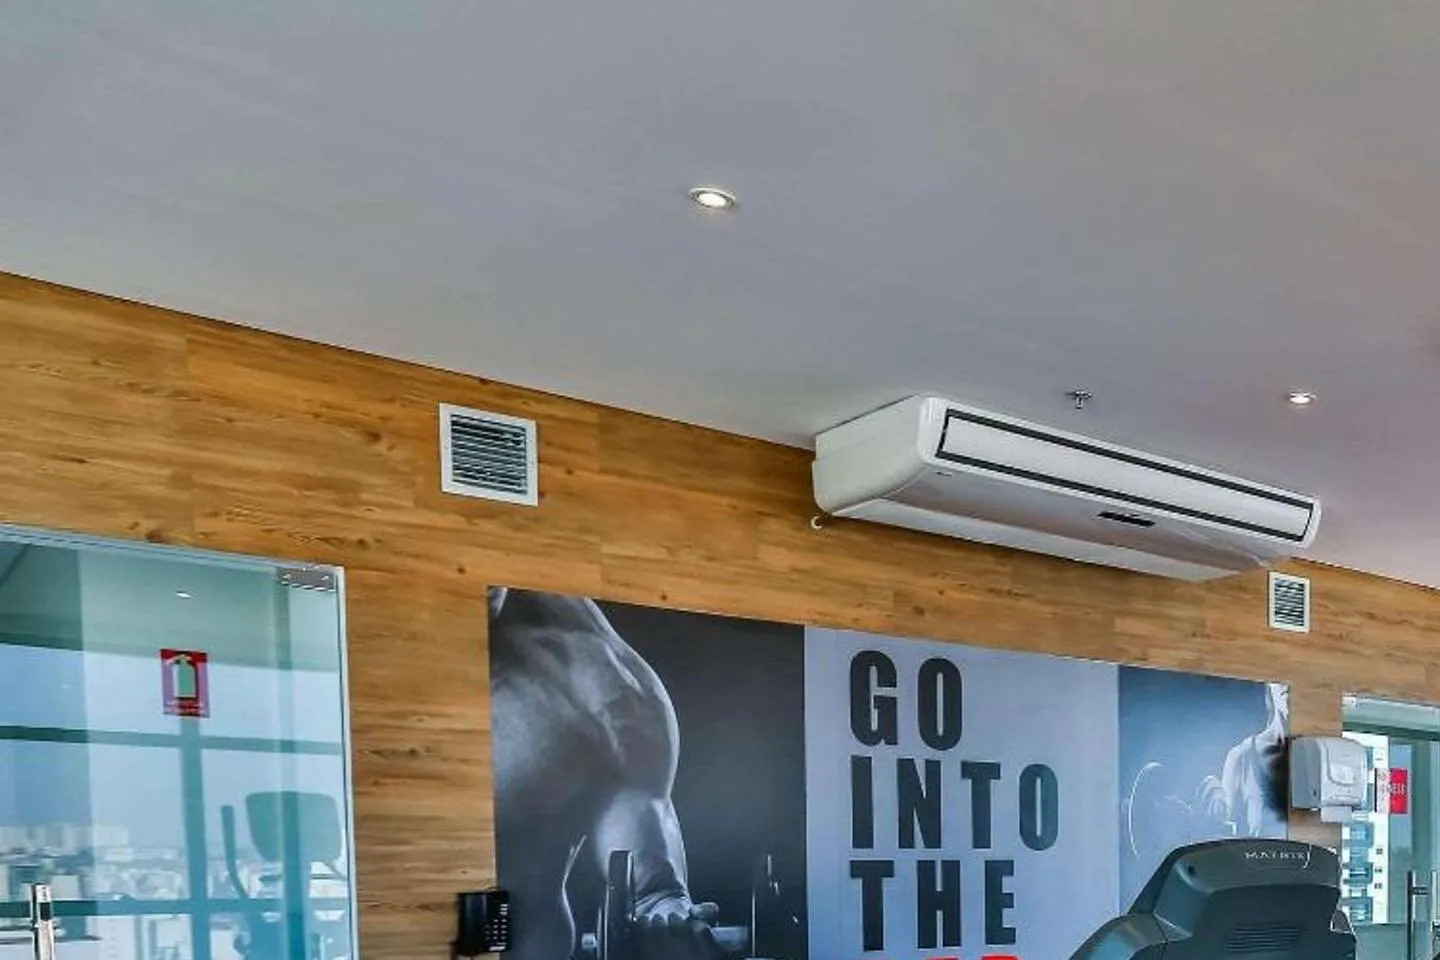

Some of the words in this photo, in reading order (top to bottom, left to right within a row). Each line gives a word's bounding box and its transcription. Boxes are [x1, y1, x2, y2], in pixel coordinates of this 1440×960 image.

[850, 650, 962, 750] GO
[851, 755, 1059, 850] INTO
[850, 860, 1016, 951] THE
